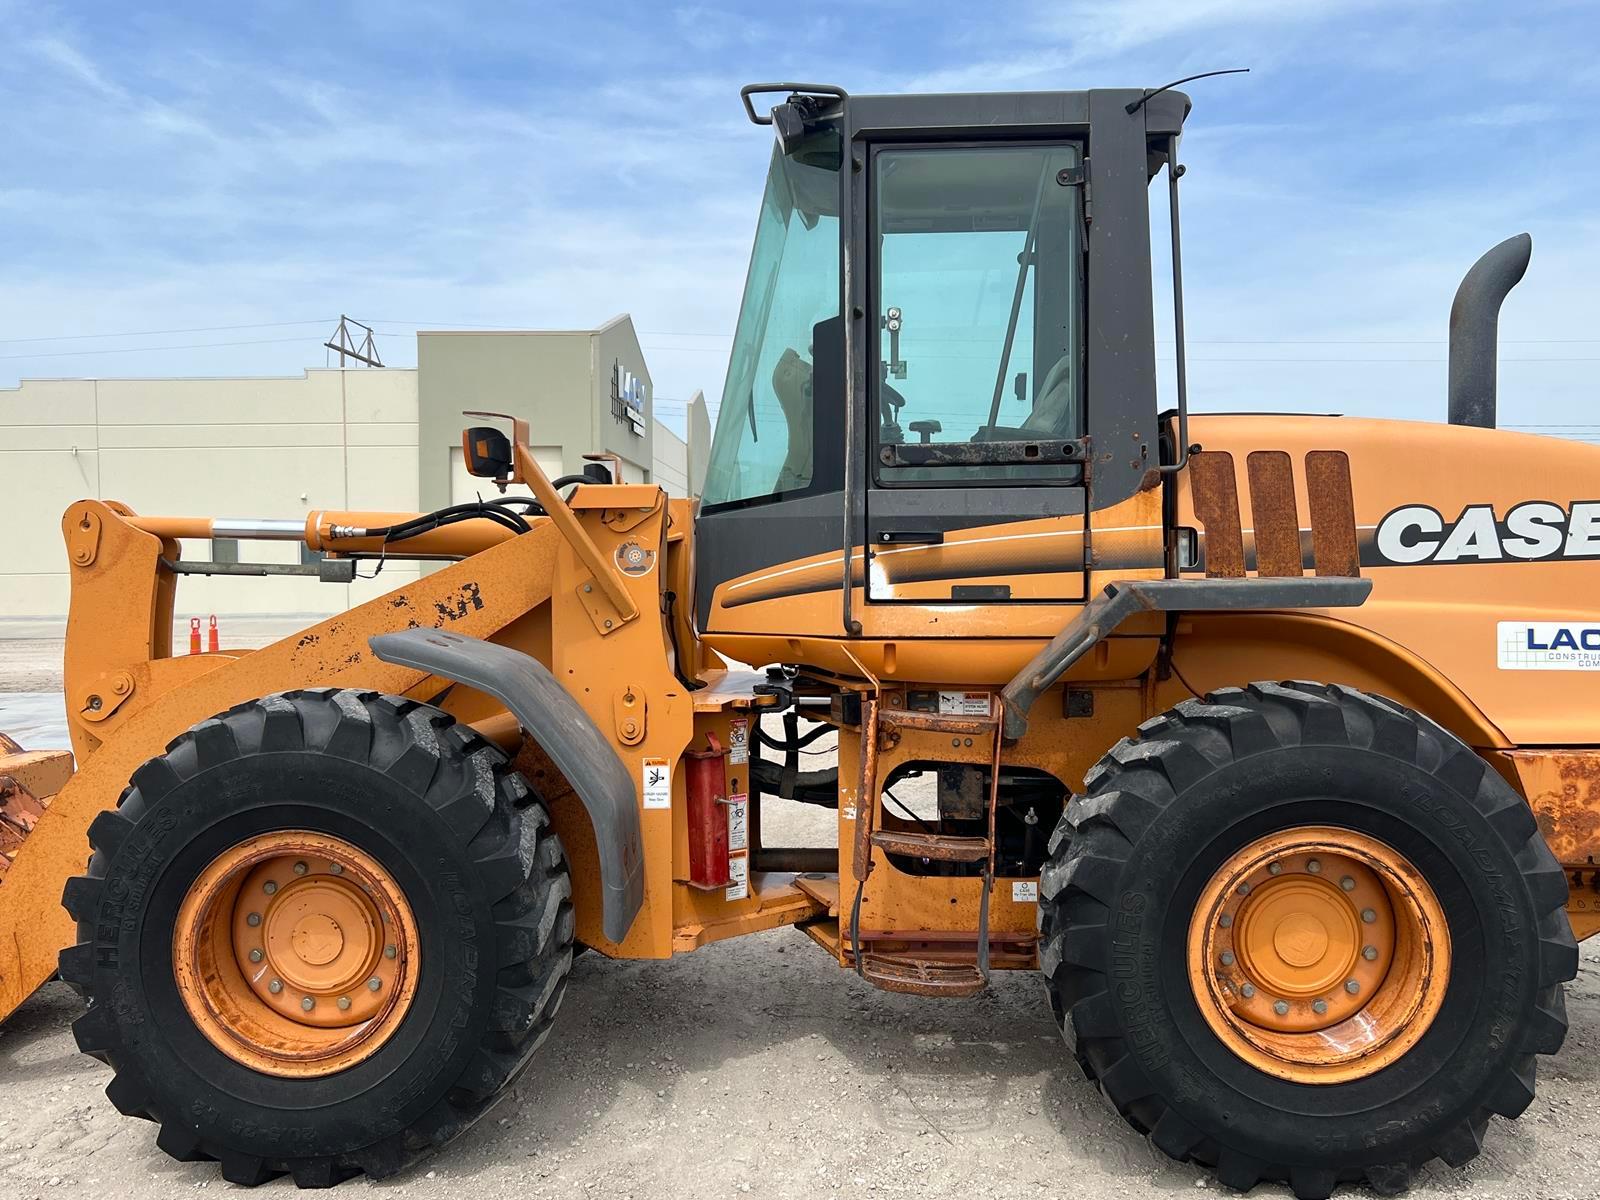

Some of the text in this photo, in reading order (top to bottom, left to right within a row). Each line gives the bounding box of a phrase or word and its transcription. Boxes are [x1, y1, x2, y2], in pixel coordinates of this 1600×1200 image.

[1377, 502, 1600, 563] CASE
[1527, 629, 1600, 650] LAC
[97, 807, 177, 969] HERCULES
[1111, 889, 1170, 1072] HERCULES
